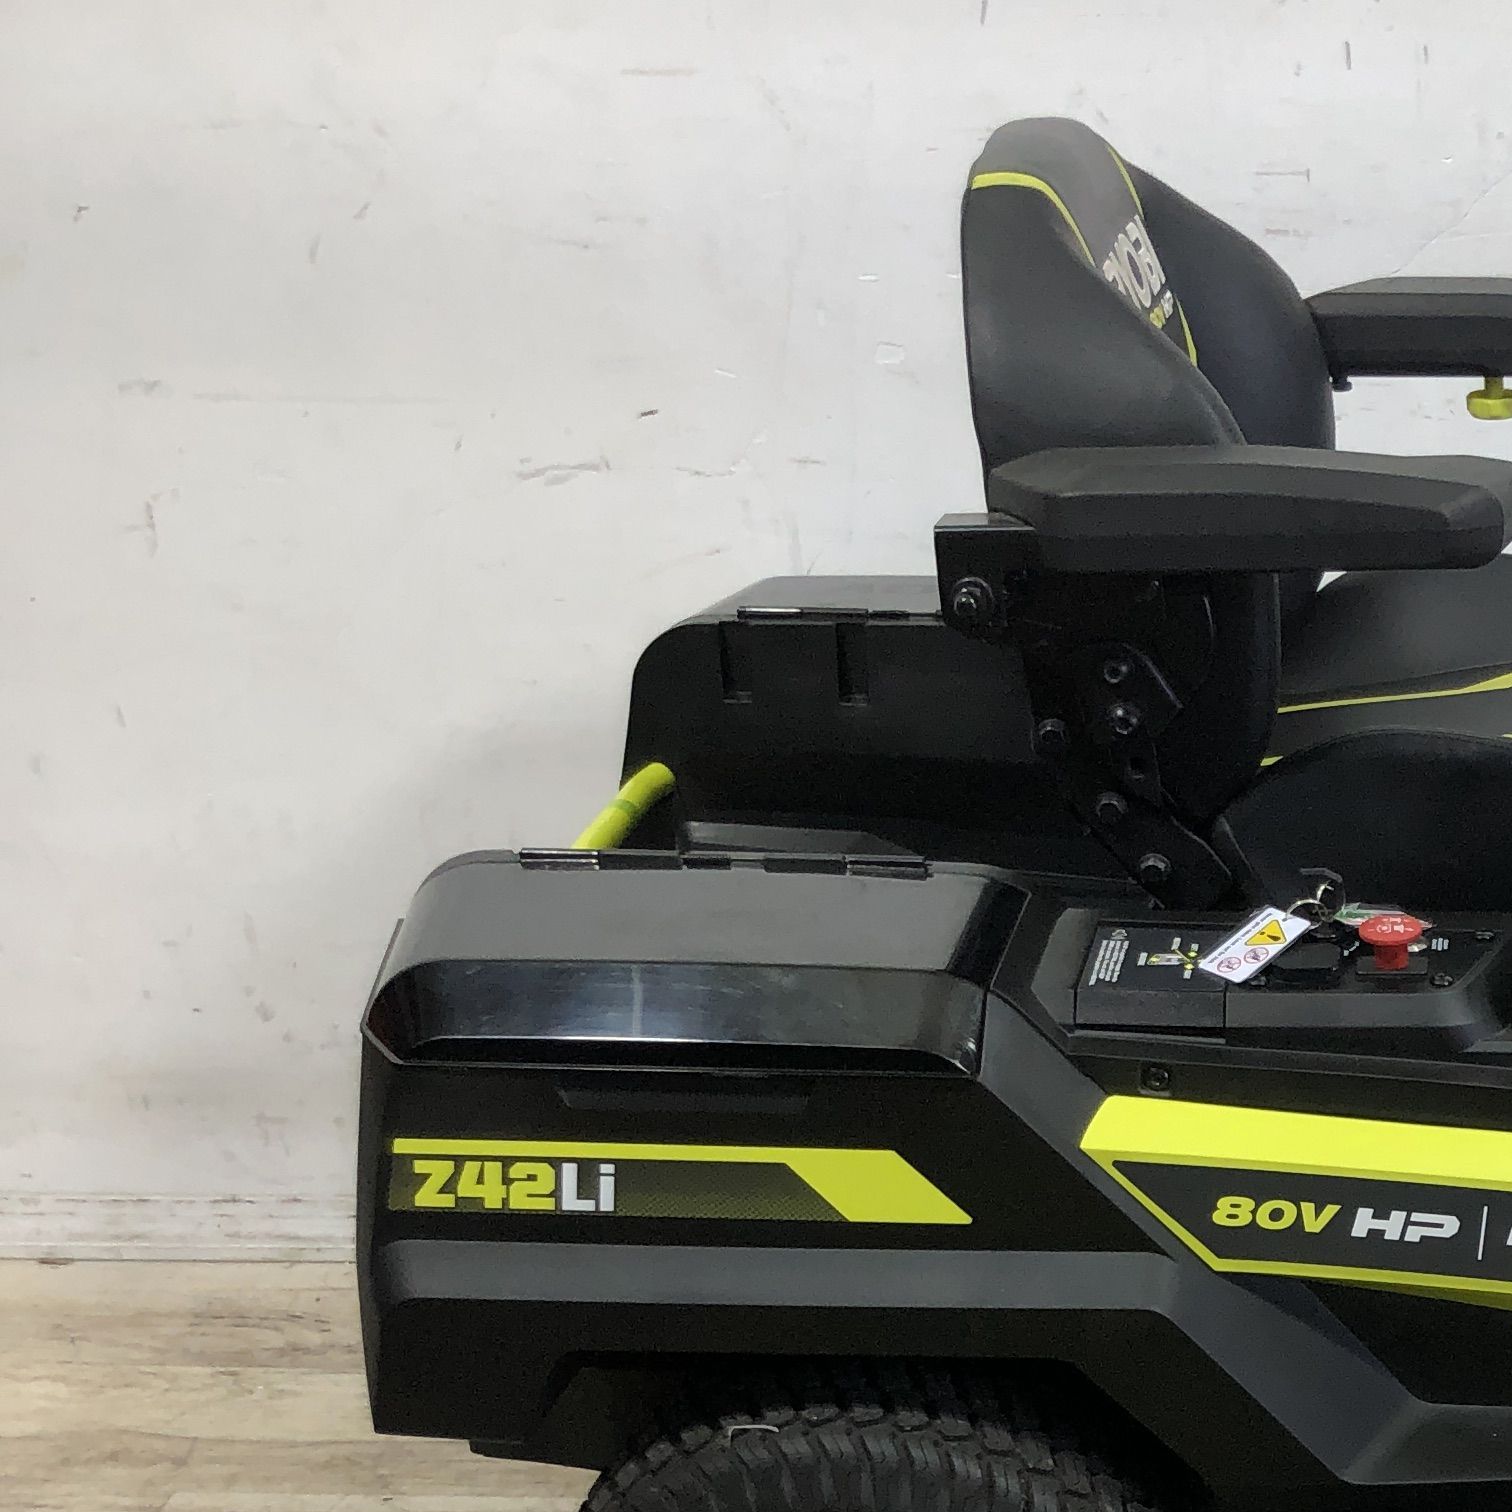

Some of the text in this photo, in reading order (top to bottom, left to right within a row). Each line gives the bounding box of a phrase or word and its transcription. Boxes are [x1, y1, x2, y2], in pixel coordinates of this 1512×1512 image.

[413, 1159, 616, 1212] Z42Li
[1212, 1196, 1342, 1234] 80V
[1350, 1206, 1461, 1243] HP
